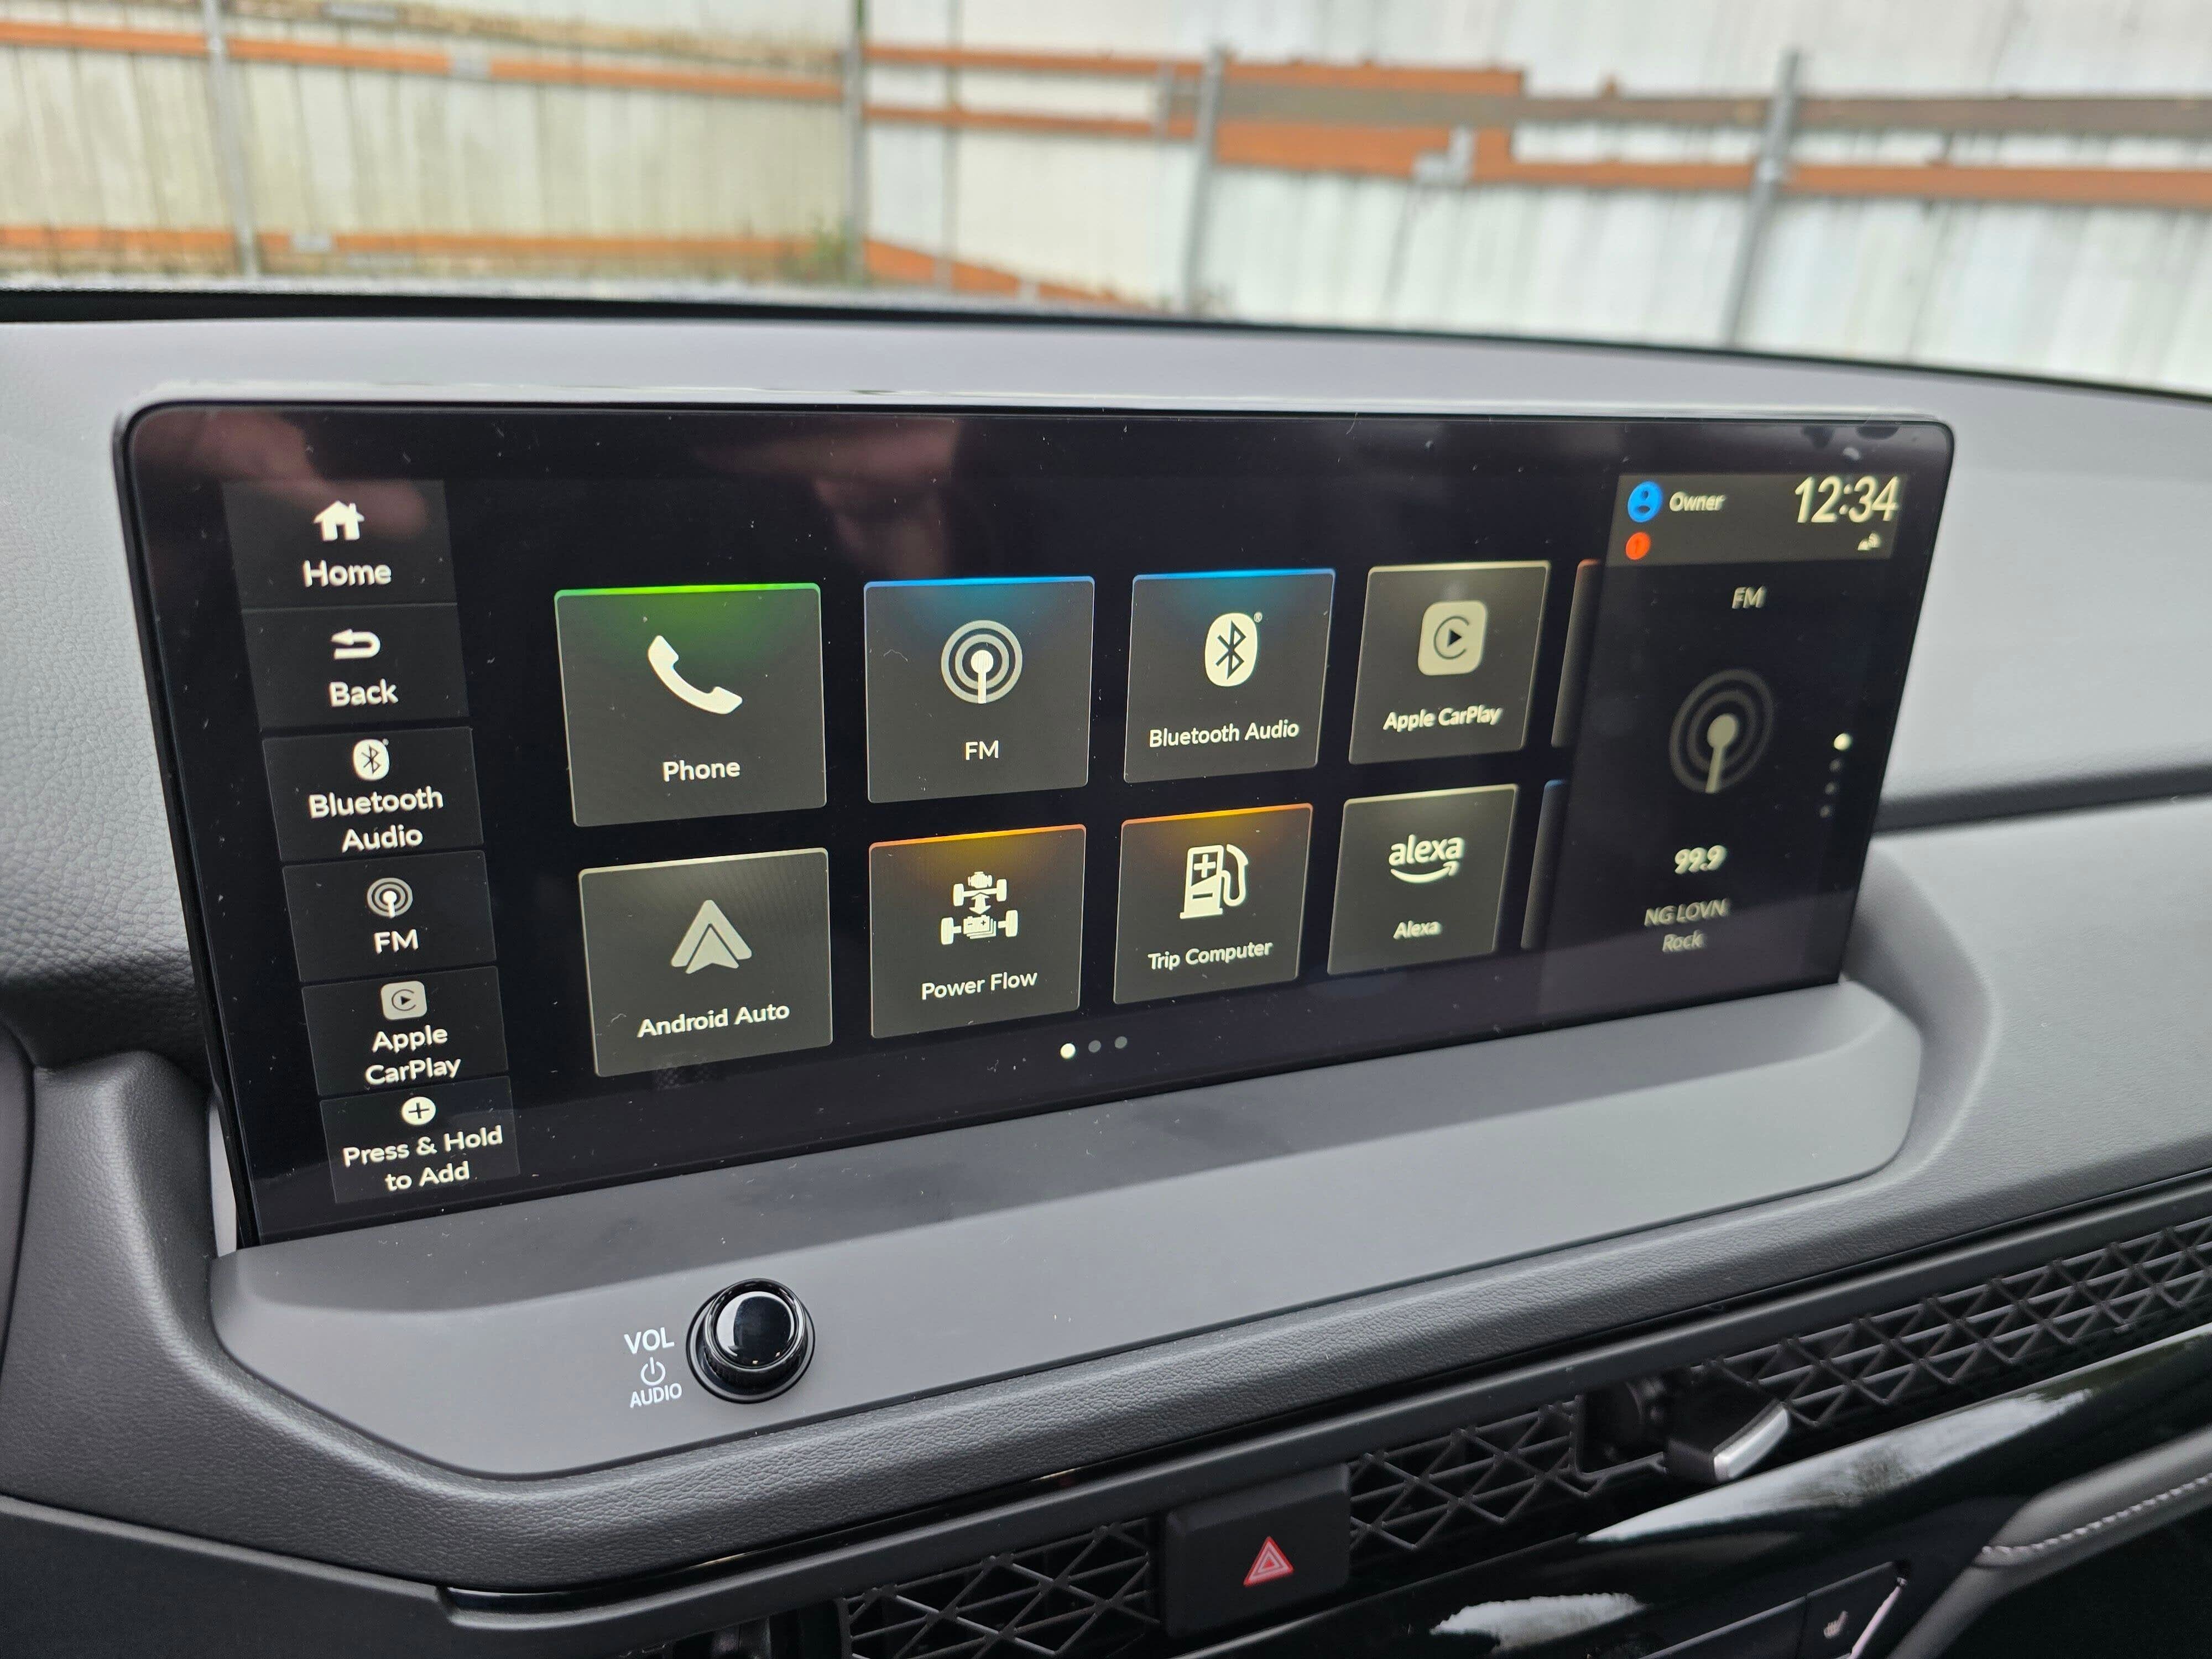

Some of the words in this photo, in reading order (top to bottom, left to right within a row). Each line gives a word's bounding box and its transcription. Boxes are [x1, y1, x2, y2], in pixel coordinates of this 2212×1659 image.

[1669, 491, 1729, 512] Owner
[1794, 476, 1901, 523] 12:34
[302, 559, 392, 587] Home
[1731, 586, 1767, 609] FM
[328, 679, 398, 707] Back
[1383, 709, 1435, 732] Apple
[1438, 705, 1503, 726] CarPlay
[1149, 723, 1240, 748] Bluetooth
[1245, 719, 1300, 740] Audio
[964, 740, 999, 761] FM
[662, 760, 741, 782] Phone
[308, 786, 444, 819] Bluetooth
[342, 825, 423, 853] Audio
[1389, 834, 1465, 867] alexa
[1674, 844, 1728, 874] 99.9
[373, 928, 419, 954] FM
[1393, 920, 1442, 940] Alexa
[1662, 930, 1708, 952] Rock
[1148, 951, 1181, 971] Trip
[1185, 941, 1274, 966] Computer
[921, 979, 985, 1000] Power
[990, 971, 1037, 991] Flow
[637, 1008, 728, 1038] Android
[734, 1003, 790, 1026] Auto
[372, 1025, 448, 1053] Apple
[365, 1057, 461, 1085] CarPlay
[342, 1144, 409, 1167] Press
[415, 1136, 436, 1156] &
[444, 1125, 503, 1152] Hold
[385, 1170, 412, 1192] to
[419, 1161, 470, 1187] Add
[623, 1327, 675, 1354] VOL
[630, 1383, 682, 1408] AUDIO
